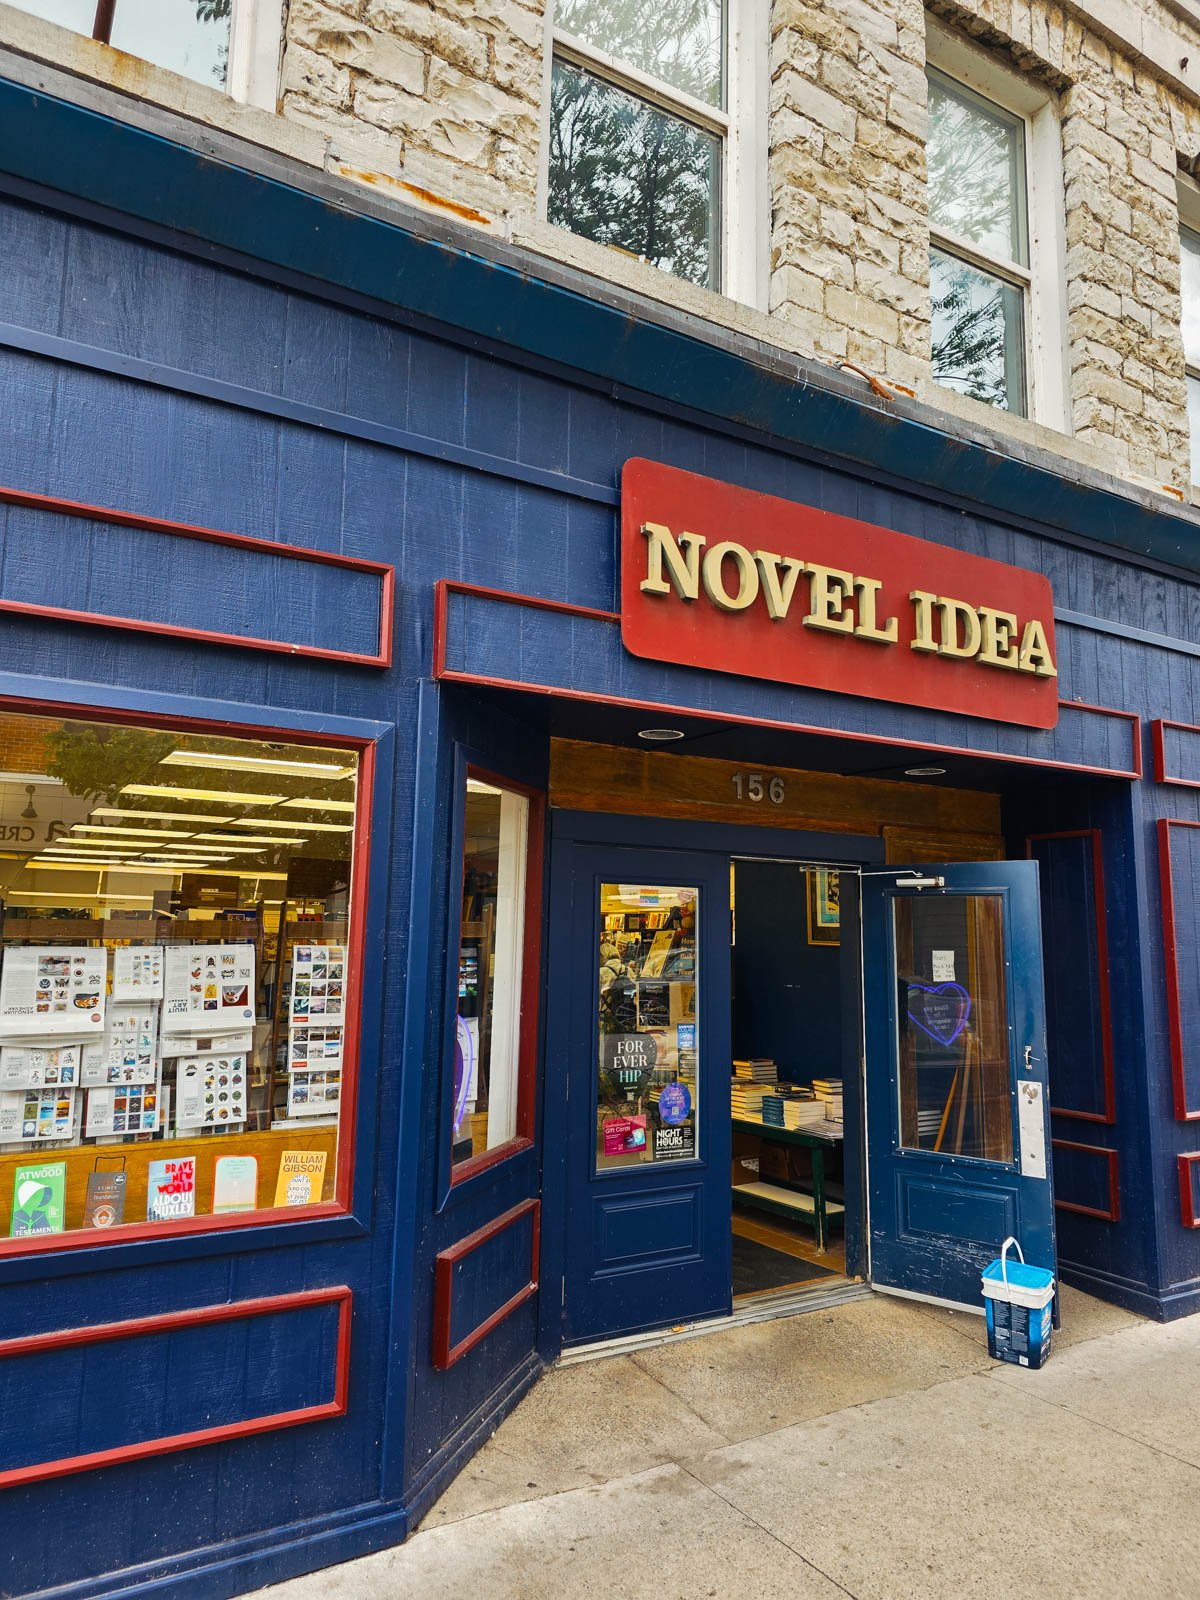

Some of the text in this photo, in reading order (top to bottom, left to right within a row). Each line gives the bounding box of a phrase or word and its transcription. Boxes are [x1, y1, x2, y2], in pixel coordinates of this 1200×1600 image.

[640, 521, 1057, 677] NOVEL IDEA
[731, 771, 785, 803] 156
[617, 1040, 644, 1054] FOR
[613, 1054, 648, 1069] EVER
[619, 1069, 642, 1083] HIP
[656, 1128, 681, 1138] NIGHT
[656, 1136, 683, 1147] HOURS
[284, 1155, 324, 1164] WILLIAM
[165, 1160, 194, 1174] BRAVE
[283, 1163, 323, 1173] GIBSON
[18, 1168, 63, 1180] ATWOOD
[172, 1171, 193, 1183] NEW
[157, 1181, 193, 1194] WORLD
[155, 1202, 193, 1216] HUXLEY
